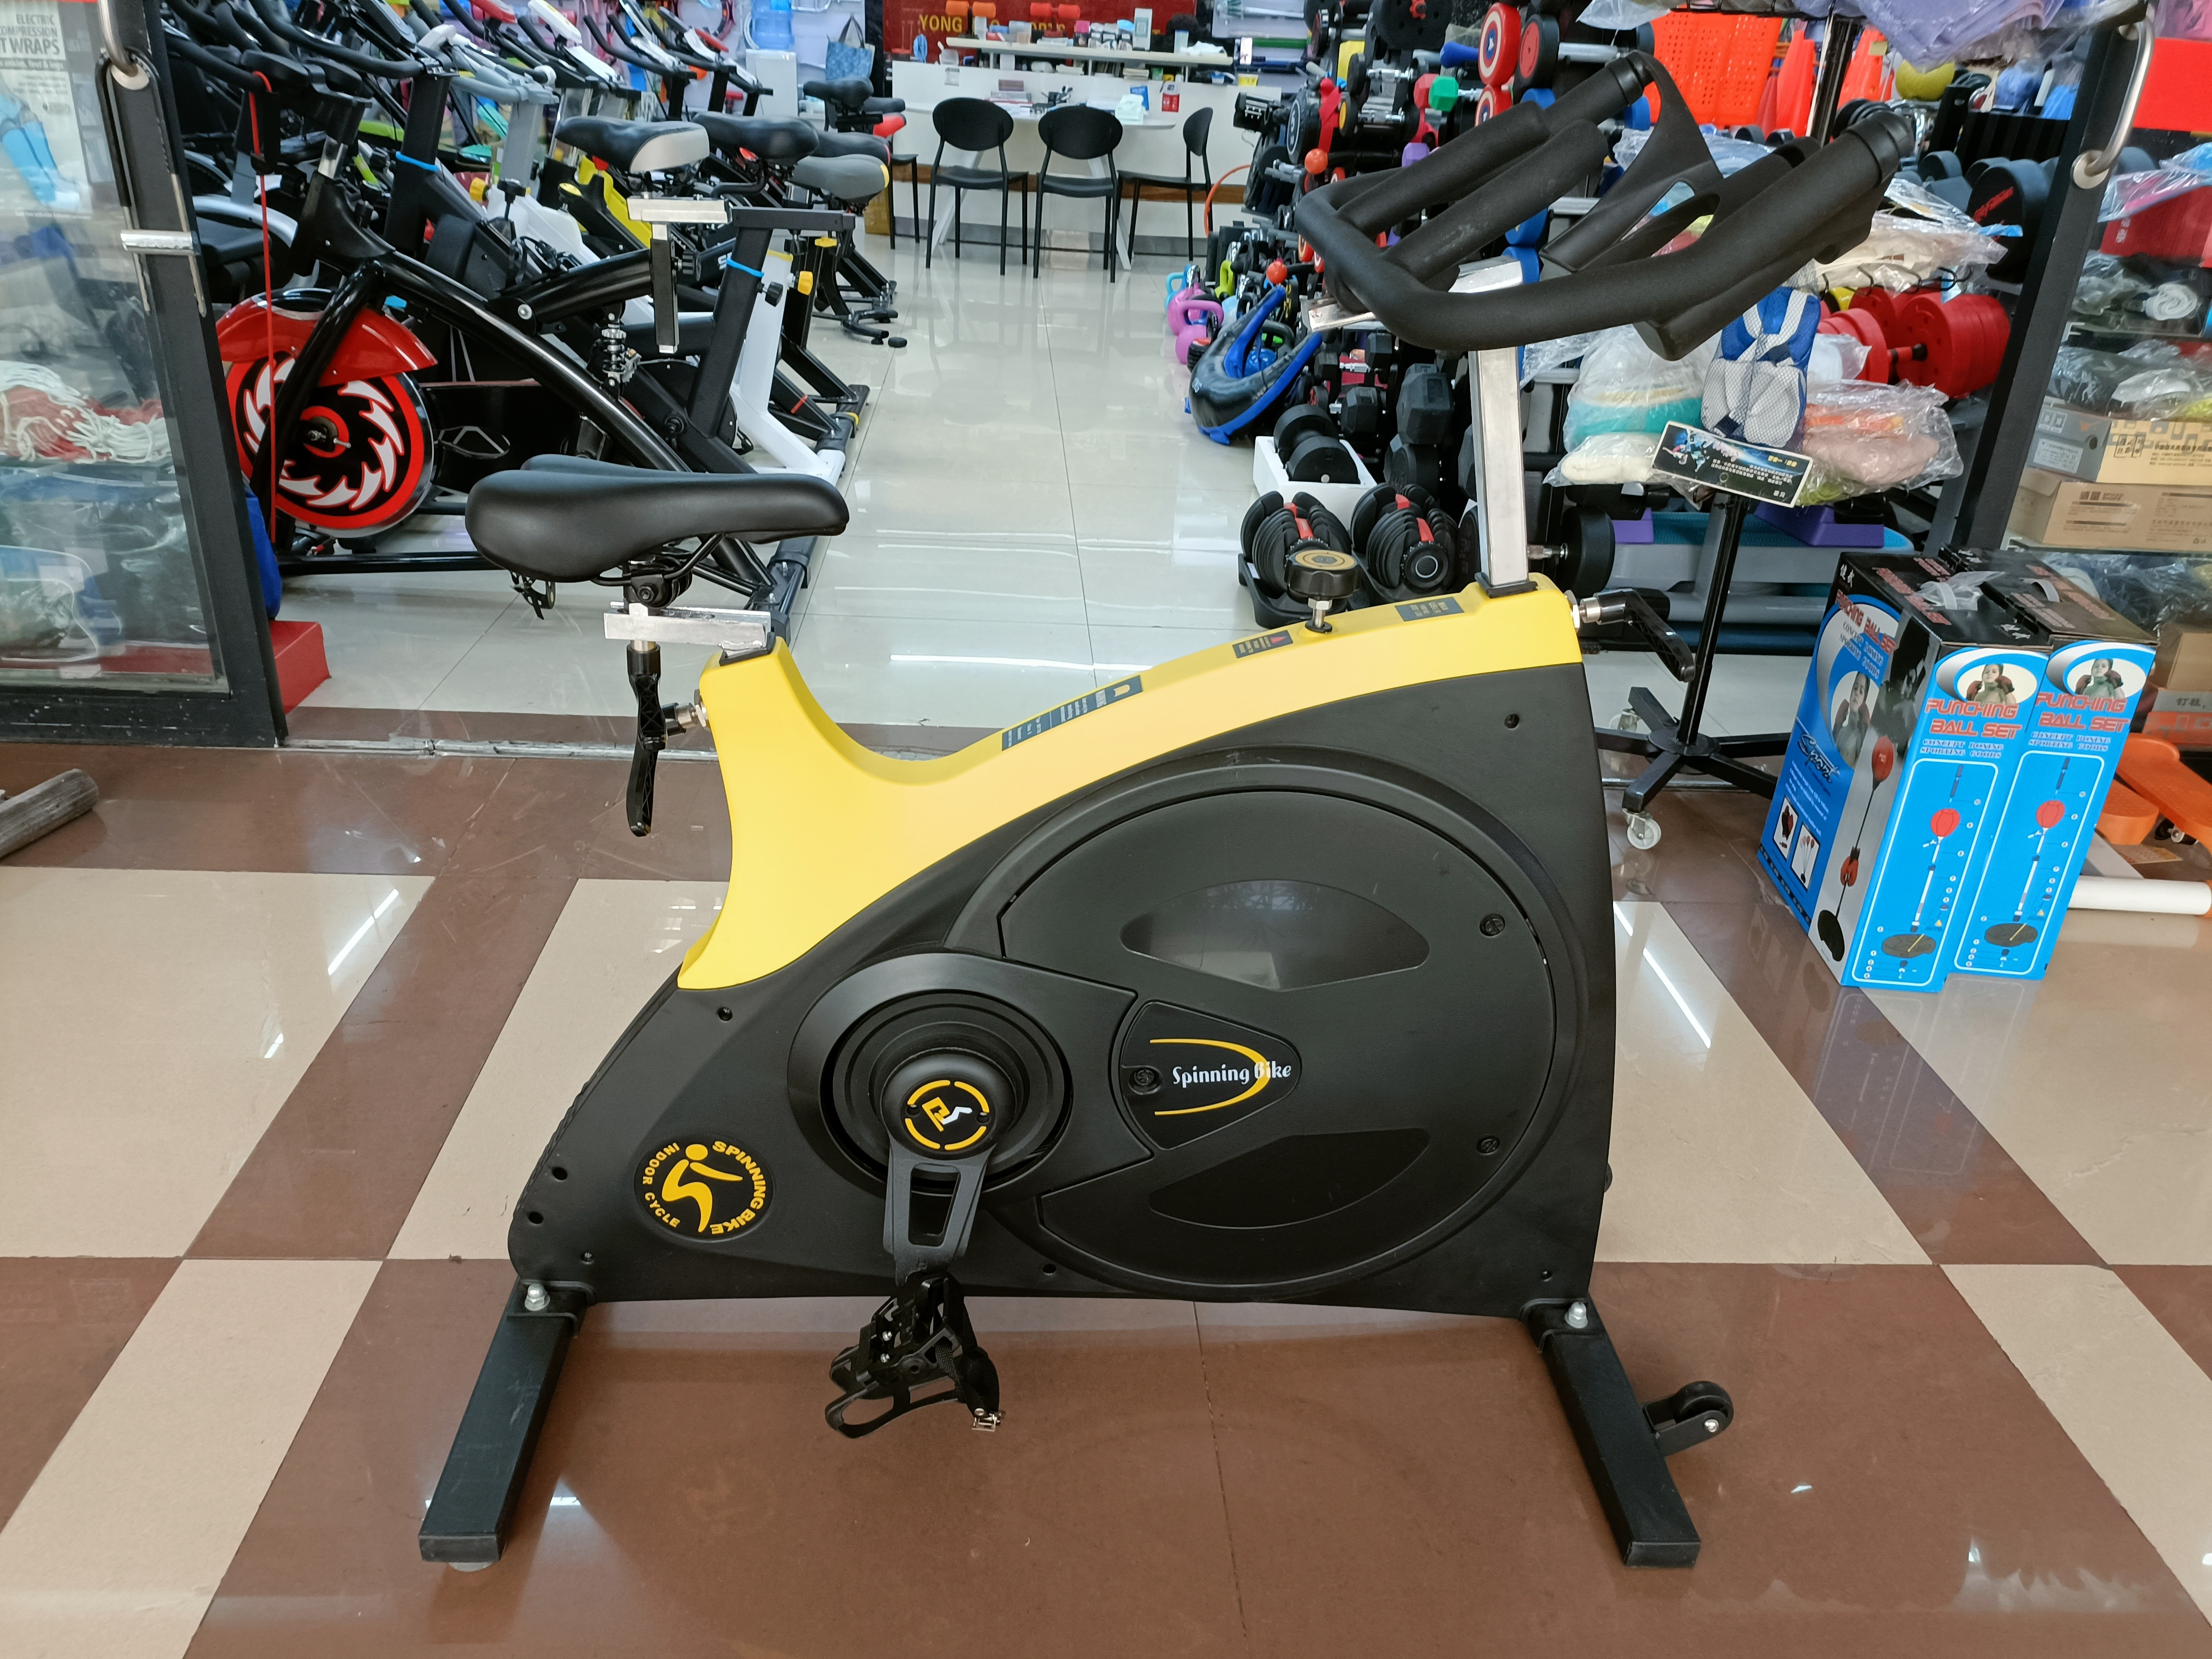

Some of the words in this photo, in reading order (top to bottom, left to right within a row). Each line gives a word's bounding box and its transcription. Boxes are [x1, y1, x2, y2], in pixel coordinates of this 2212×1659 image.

[16, 13, 55, 25] ELECTRIC
[919, 14, 962, 33] YONG
[9, 38, 60, 55] WRAPS
[1863, 616, 1880, 645] BALL
[1924, 698, 2020, 719] PUNCHING
[2035, 692, 2128, 713] PUNCHING
[1929, 719, 1979, 737] BALL
[1981, 722, 2023, 740] SET
[2037, 712, 2086, 730] BALL
[2088, 716, 2130, 733] SET
[1172, 1063, 1250, 1088] Spinning
[1254, 1061, 1292, 1080] Bike
[642, 1142, 680, 1185] INDOOR
[712, 1141, 766, 1210] SPINNING
[645, 1192, 680, 1228] CYCLE
[710, 1208, 756, 1235] BIKE
